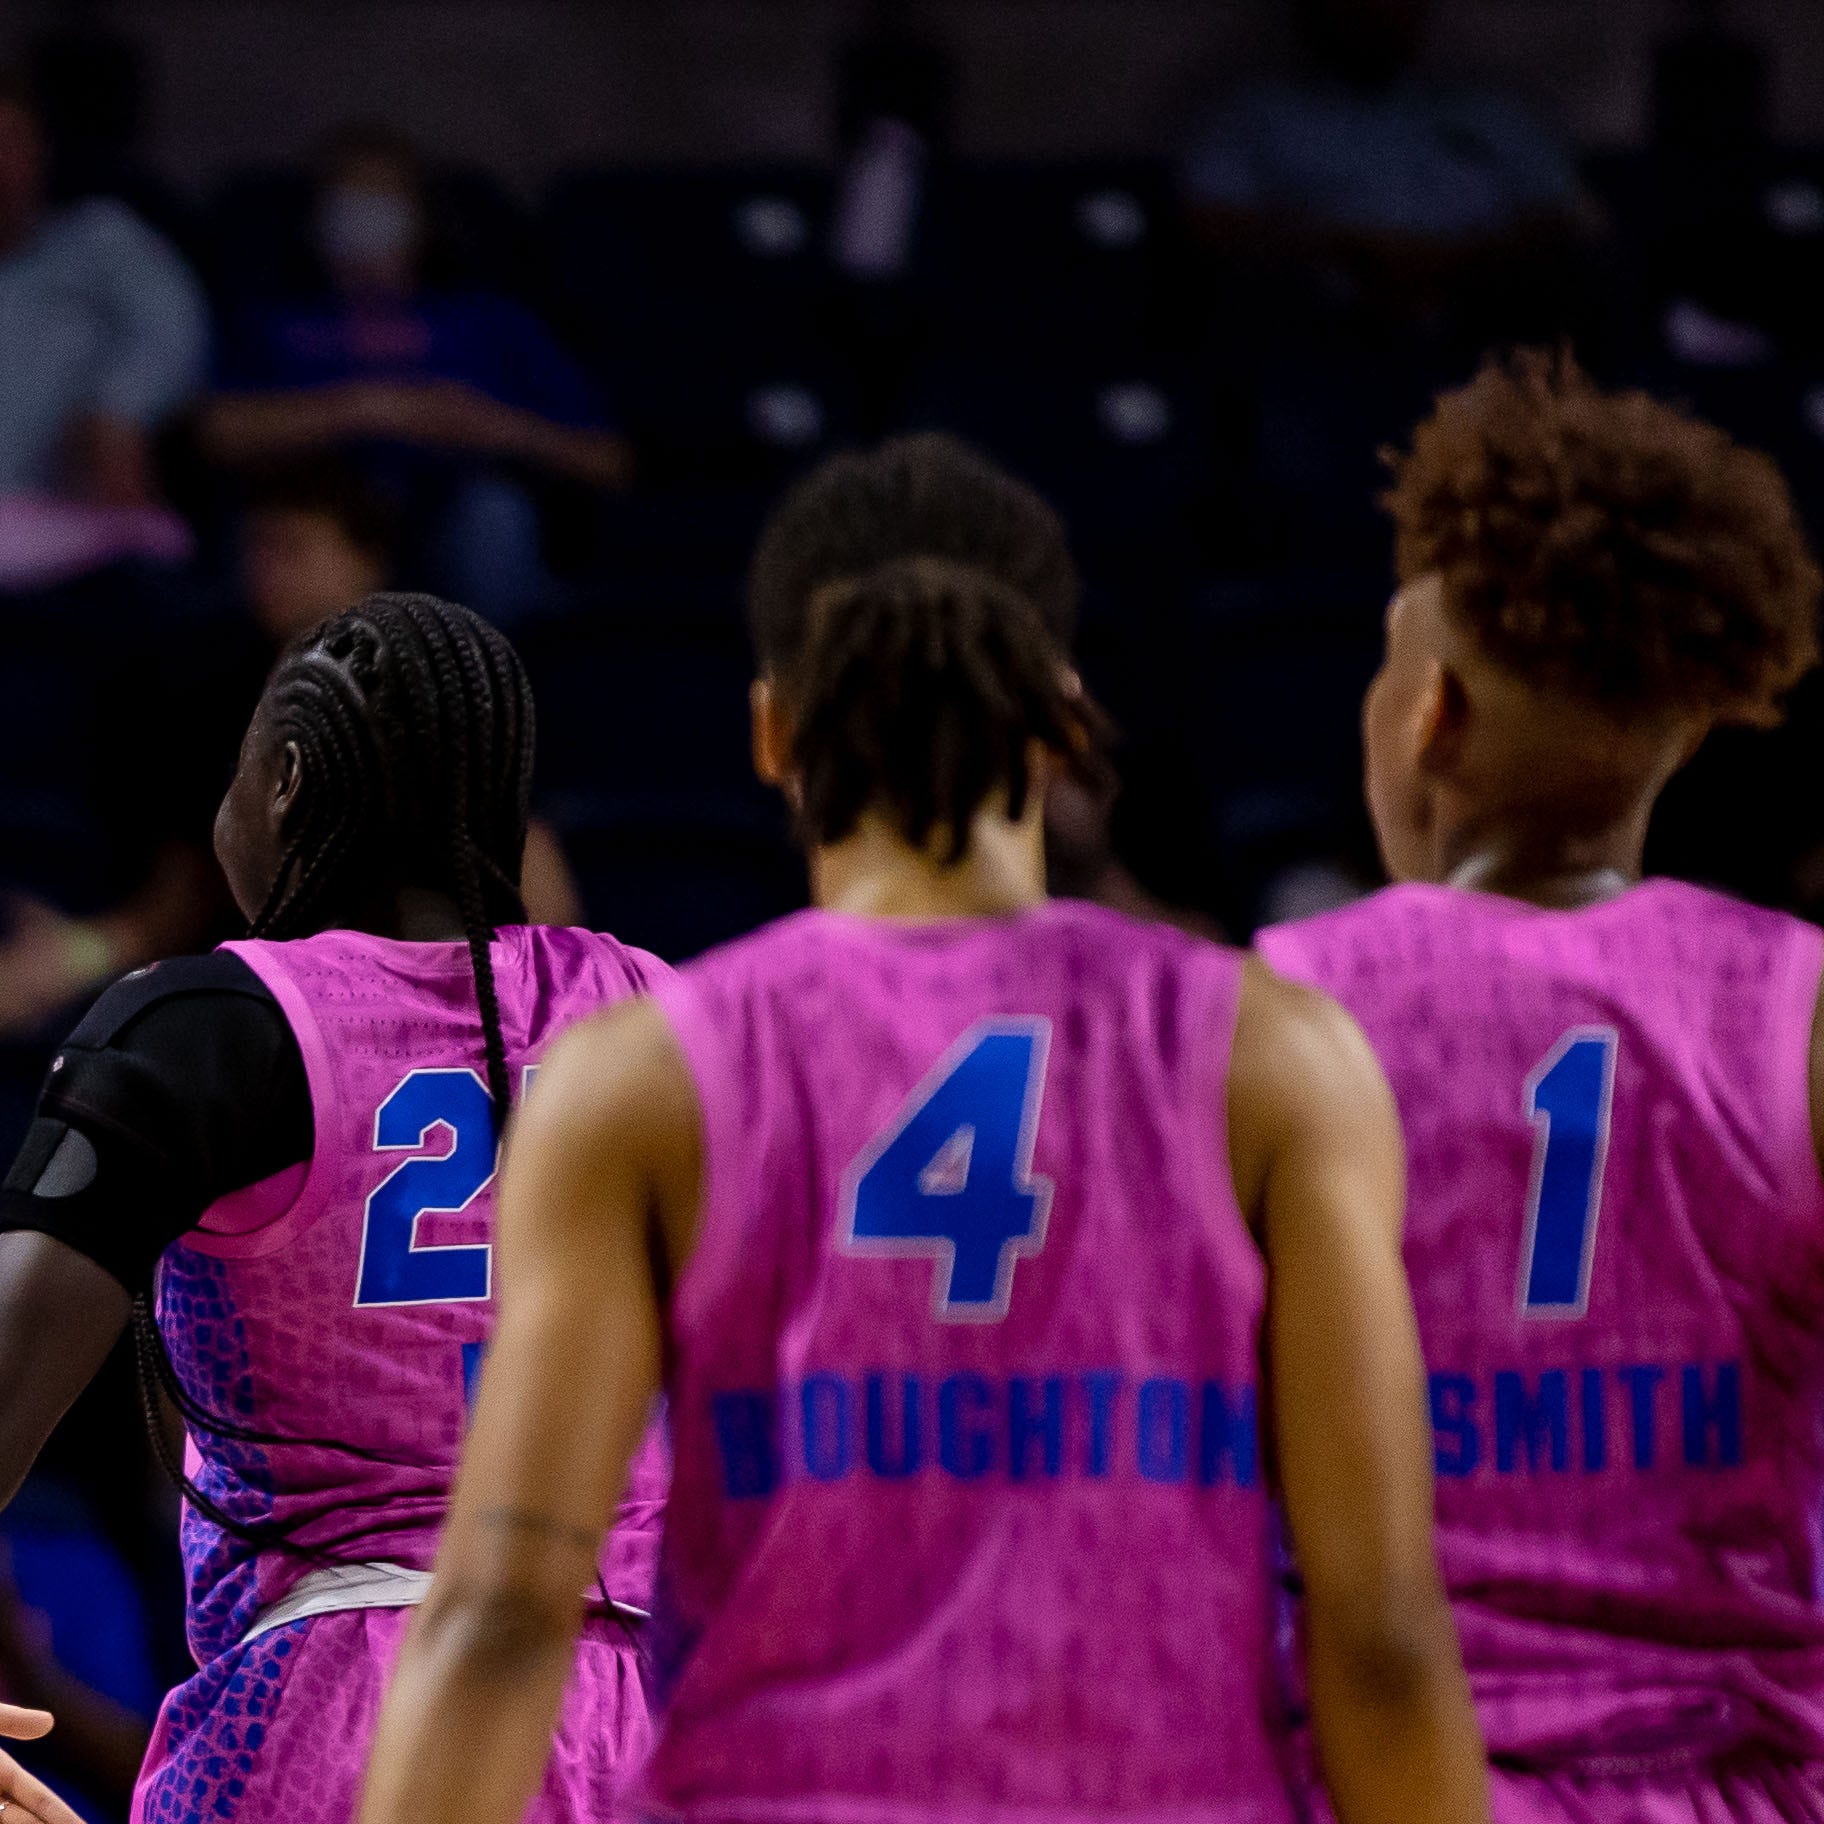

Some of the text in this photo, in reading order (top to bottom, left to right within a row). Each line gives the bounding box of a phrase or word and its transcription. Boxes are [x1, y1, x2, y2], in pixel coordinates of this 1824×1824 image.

[353, 1066, 544, 1308] 2
[838, 1015, 1054, 1324] 4
[1517, 1024, 1619, 1320] 1
[1427, 1360, 1742, 1478] SMITH
